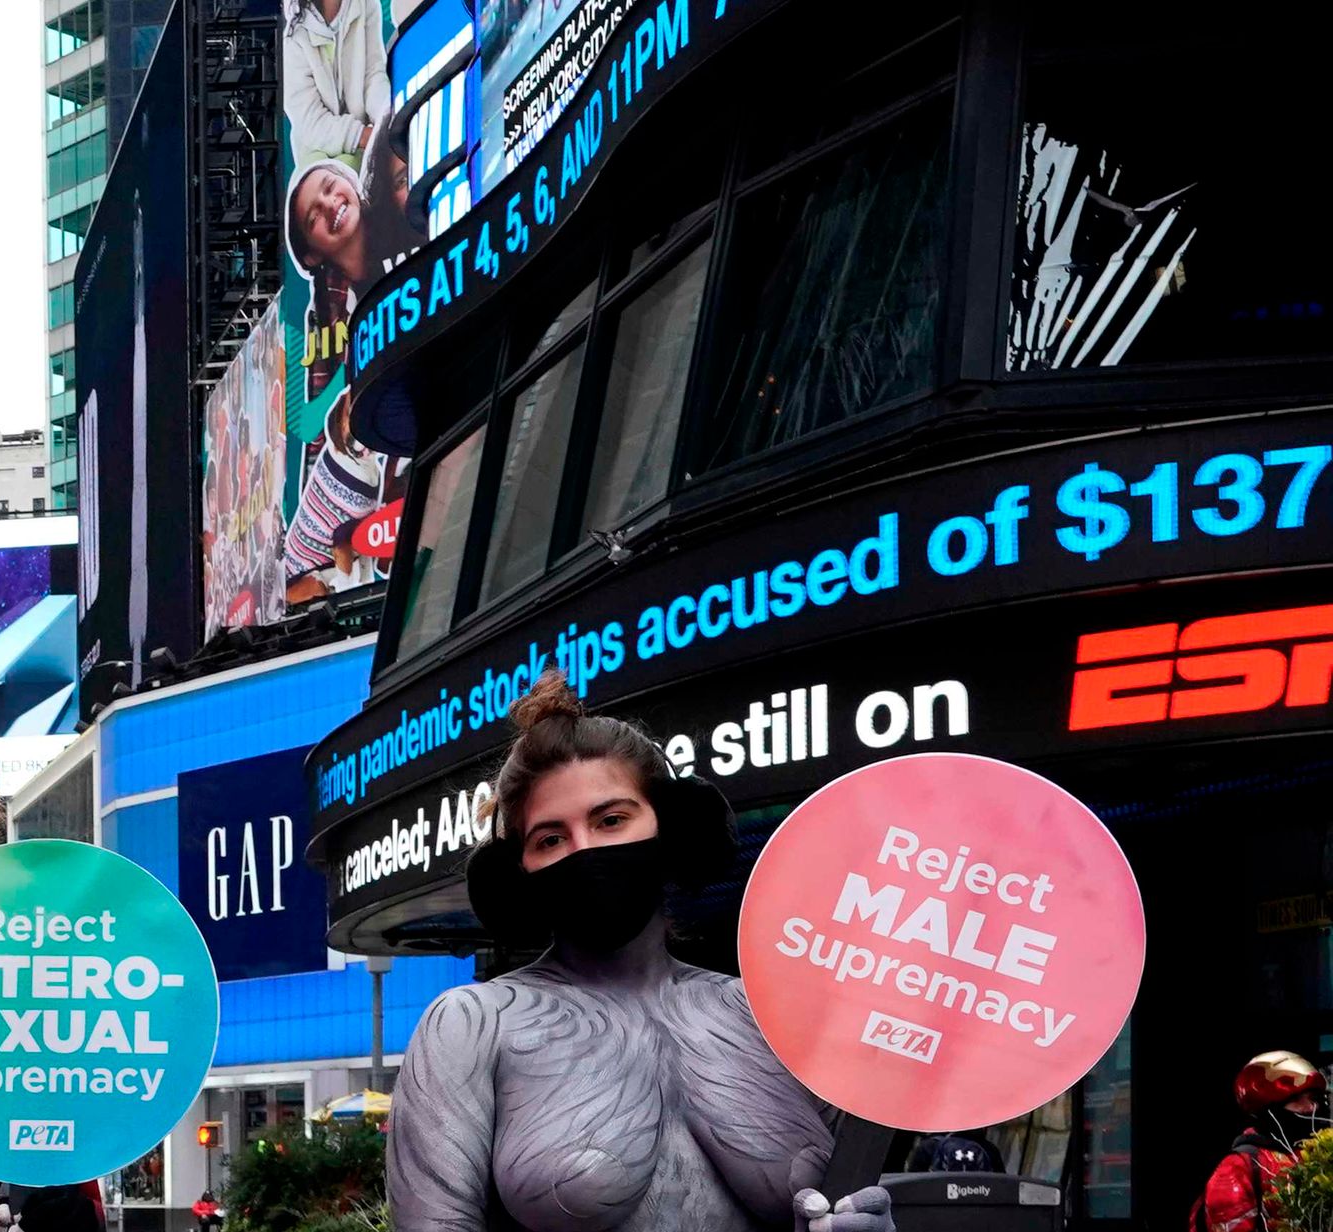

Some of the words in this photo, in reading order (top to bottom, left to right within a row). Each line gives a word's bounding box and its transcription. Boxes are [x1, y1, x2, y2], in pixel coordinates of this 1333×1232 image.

[503, 36, 563, 119] SCREENING
[564, 0, 612, 50] PLATFO
[523, 87, 548, 133] NEW
[549, 51, 580, 103] YORK
[582, 18, 609, 67] CITY
[427, 238, 469, 316] AT
[474, 221, 499, 279] 4,
[506, 192, 529, 253] 5,
[534, 165, 555, 225] 6,
[561, 89, 603, 199] AND
[360, 688, 462, 798] pandemic
[555, 622, 625, 699] tips
[637, 512, 899, 660] accused
[927, 484, 1030, 578] of
[1055, 444, 1332, 563] $137
[345, 807, 430, 893] canceled;
[710, 683, 829, 778] still
[855, 679, 970, 750] on
[206, 815, 294, 922] GAP
[876, 825, 1055, 914] Reject
[775, 917, 1077, 1048] Supremacy
[832, 872, 1058, 985] MALE
[947, 1183, 990, 1199] Bigbelly
